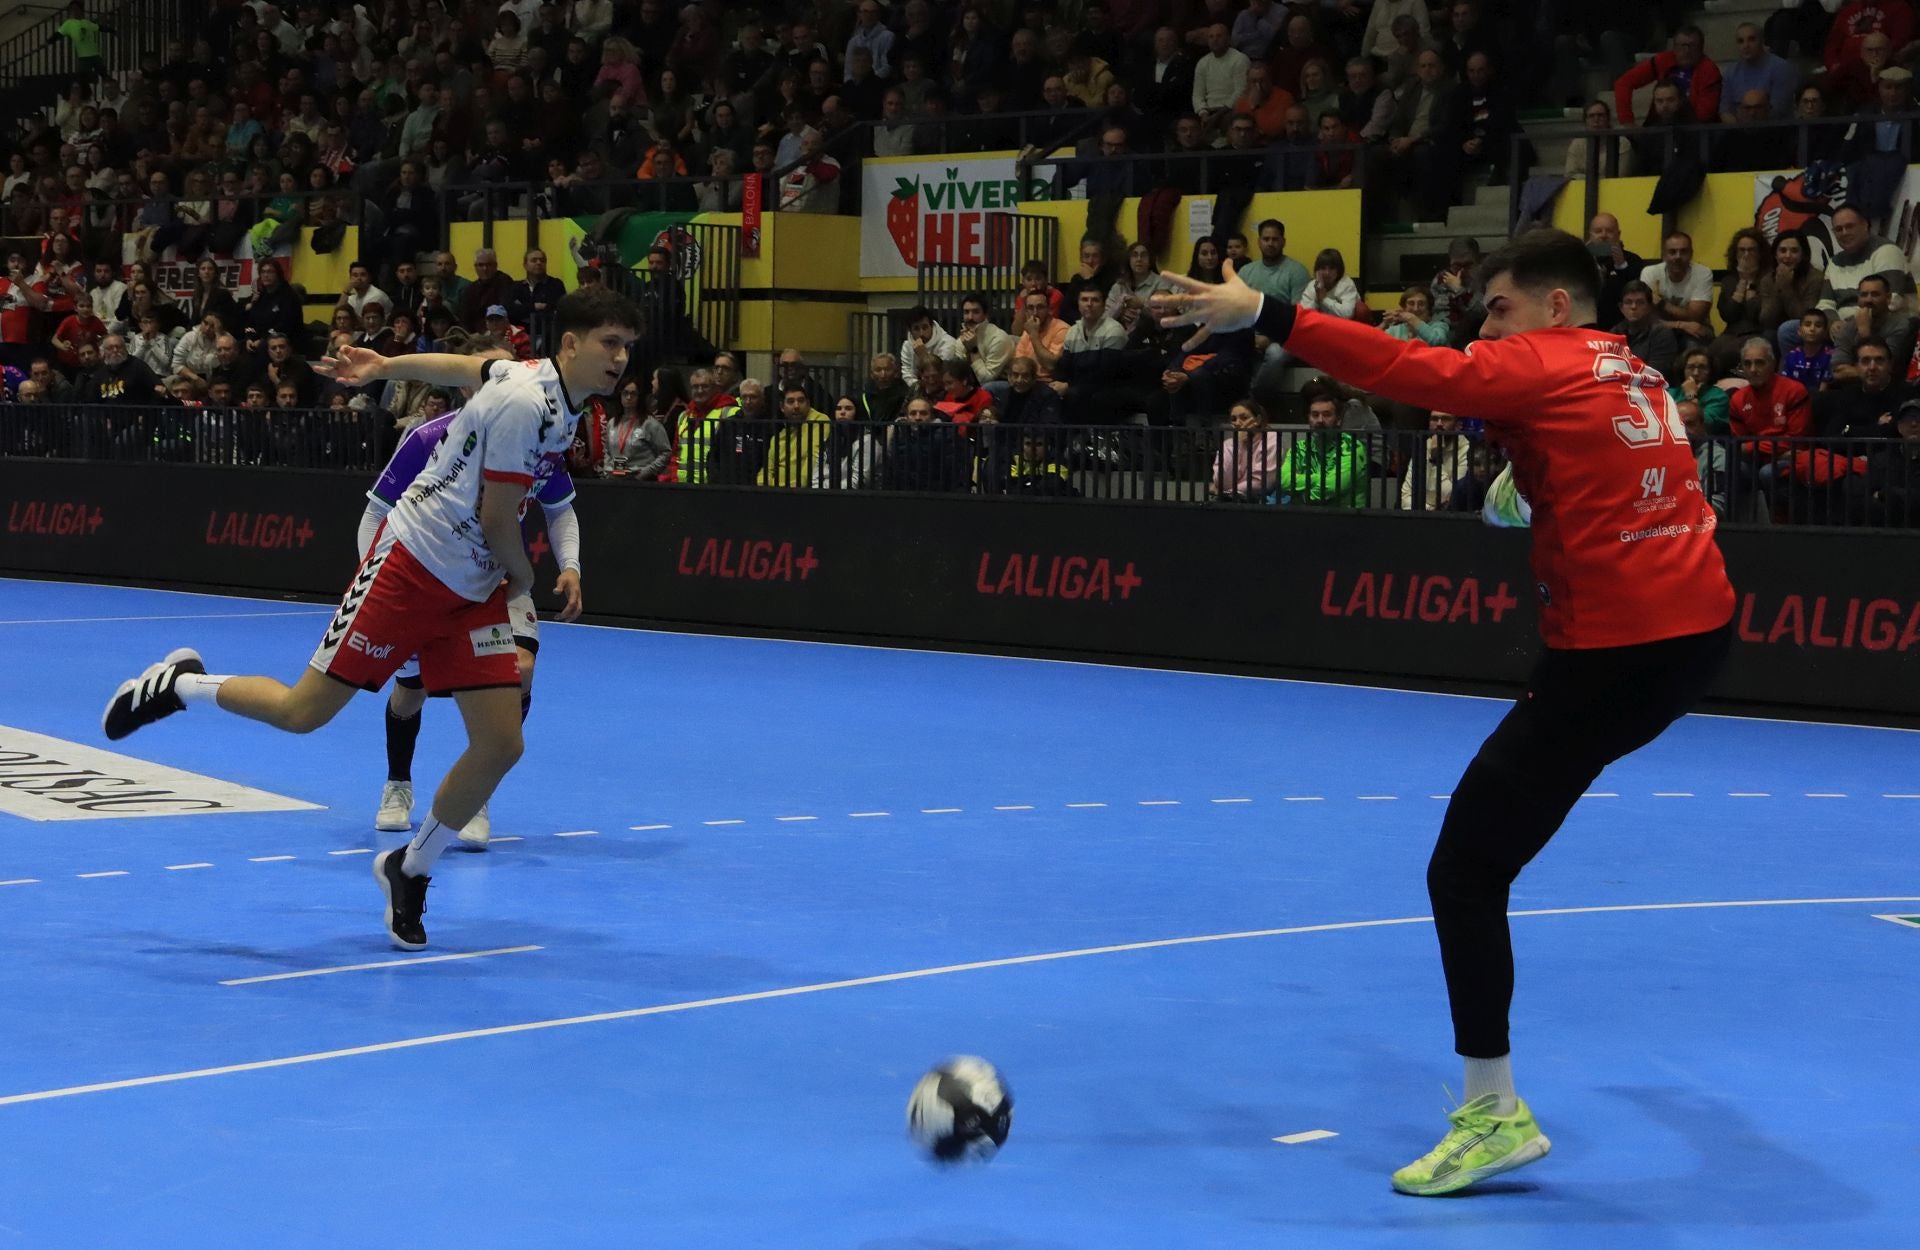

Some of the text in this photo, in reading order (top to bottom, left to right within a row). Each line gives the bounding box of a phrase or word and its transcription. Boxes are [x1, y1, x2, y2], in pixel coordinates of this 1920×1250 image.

[922, 179, 1072, 210] VIVERO
[7, 500, 104, 536] LALIGA+
[205, 510, 315, 549] LALIGA+
[1620, 523, 1691, 543] Guadalagua
[678, 536, 820, 583] LALIGA+
[976, 551, 1143, 601] LALIGA+
[1320, 570, 1518, 624] LALIGA+
